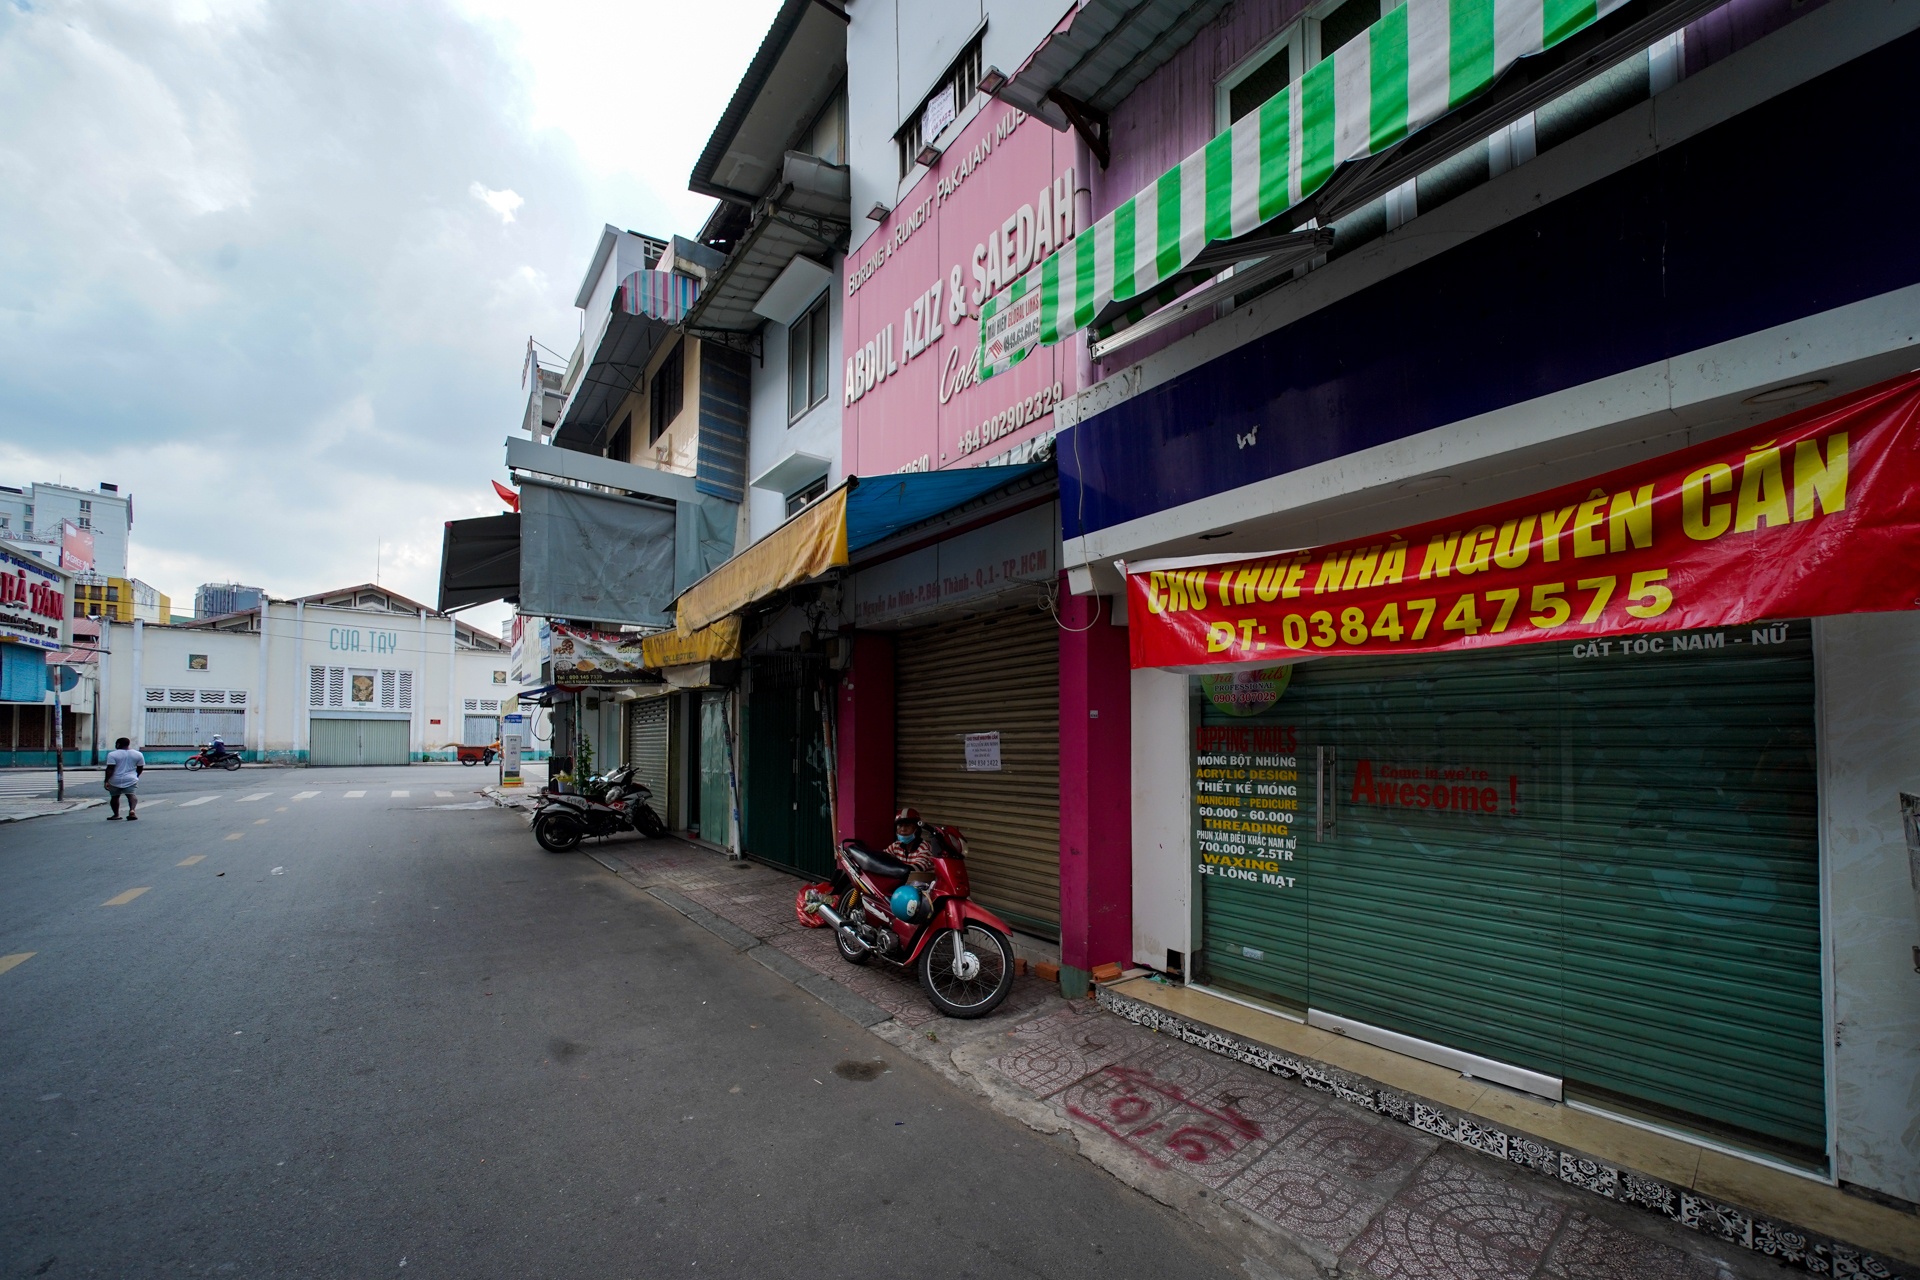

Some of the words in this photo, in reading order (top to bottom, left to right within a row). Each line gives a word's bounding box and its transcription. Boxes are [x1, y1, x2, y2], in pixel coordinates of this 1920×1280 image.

[848, 248, 884, 296] BORONG
[886, 241, 893, 257] &
[894, 194, 934, 250] RUNCIT
[936, 132, 992, 207] PAKAIAN
[844, 322, 898, 407] ABDUL
[901, 278, 944, 365] AZIZ
[948, 264, 968, 326] &
[971, 166, 1075, 306] SAEDAH
[957, 425, 981, 454] +84
[982, 381, 1063, 446] 902902329
[1147, 568, 1208, 614] CHO
[1218, 549, 1312, 607] THUÊ
[1314, 534, 1409, 595] NHÀ
[1419, 482, 1655, 582] NGUYÊN
[1681, 430, 1850, 541] CĂN
[1002, 549, 1047, 579] TP.HCM
[30, 580, 64, 621] TÂM
[1206, 618, 1267, 653] ĐT:
[1282, 568, 1674, 650] 0384747575
[1572, 638, 1613, 659] CẮT
[1619, 634, 1664, 656] TÓC
[1672, 632, 1725, 652] NAM
[1751, 622, 1789, 646] NỮ
[1214, 682, 1275, 692] PROFESSIONAL
[1213, 693, 1237, 704] 0903
[1240, 691, 1277, 703] 307028
[1196, 726, 1249, 752] DIPPING
[1253, 725, 1297, 753] NAILS
[1197, 752, 1227, 765] MÓNG
[1230, 754, 1252, 768] BỘT
[1255, 754, 1297, 767] NHÚNG
[1196, 768, 1246, 779] ACRYLIC
[1249, 770, 1297, 781] DESIGN
[1381, 765, 1419, 779] Come
[1425, 766, 1438, 779] in
[1197, 779, 1232, 792] THIẾT
[1235, 780, 1253, 794] KẾ
[1257, 782, 1297, 796] MÓNG
[1351, 759, 1498, 813] Awesome
[1196, 796, 1241, 807] MANICURE
[1249, 798, 1298, 810] PEDICURE
[1199, 807, 1238, 818] 60.000
[1249, 810, 1294, 824] 60.000
[1203, 819, 1288, 836] THREADING
[1196, 830, 1213, 841] PHUN
[1268, 837, 1284, 848] NAM
[1198, 841, 1245, 855] 700.000
[1257, 848, 1294, 861] 2.5TR
[1202, 854, 1279, 873] WAXING
[1198, 864, 1215, 875] SE
[1219, 865, 1258, 882] LÔNG
[1262, 873, 1296, 889] MẠT
